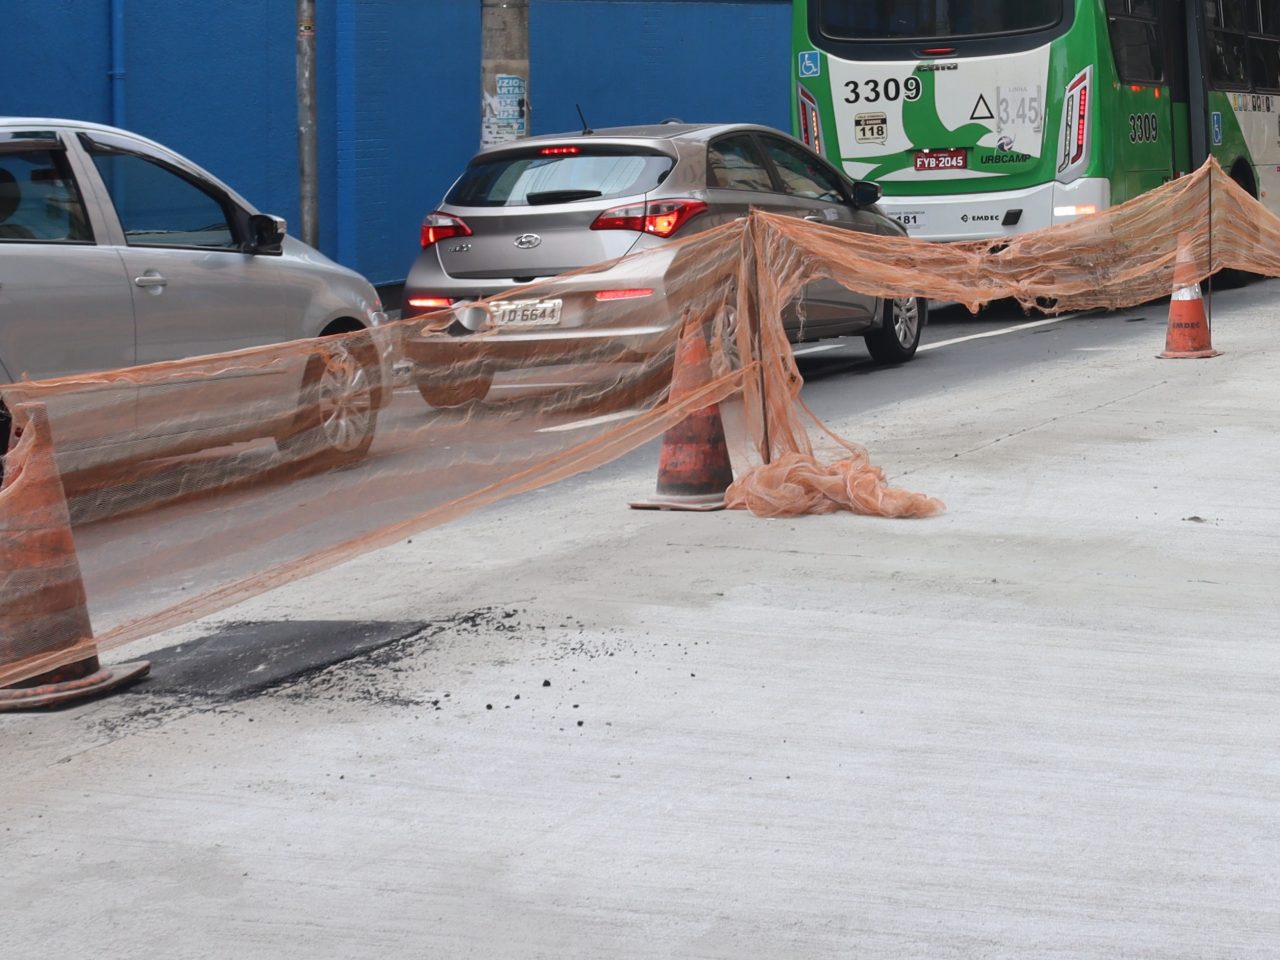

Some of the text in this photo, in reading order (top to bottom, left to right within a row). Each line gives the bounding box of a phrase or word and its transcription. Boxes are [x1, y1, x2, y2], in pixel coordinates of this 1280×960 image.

[844, 76, 922, 103] 3309
[860, 125, 884, 137] 118
[1129, 113, 1158, 143] 3309
[981, 154, 1032, 164] URBCAMP
[500, 308, 557, 322] ID-6644
